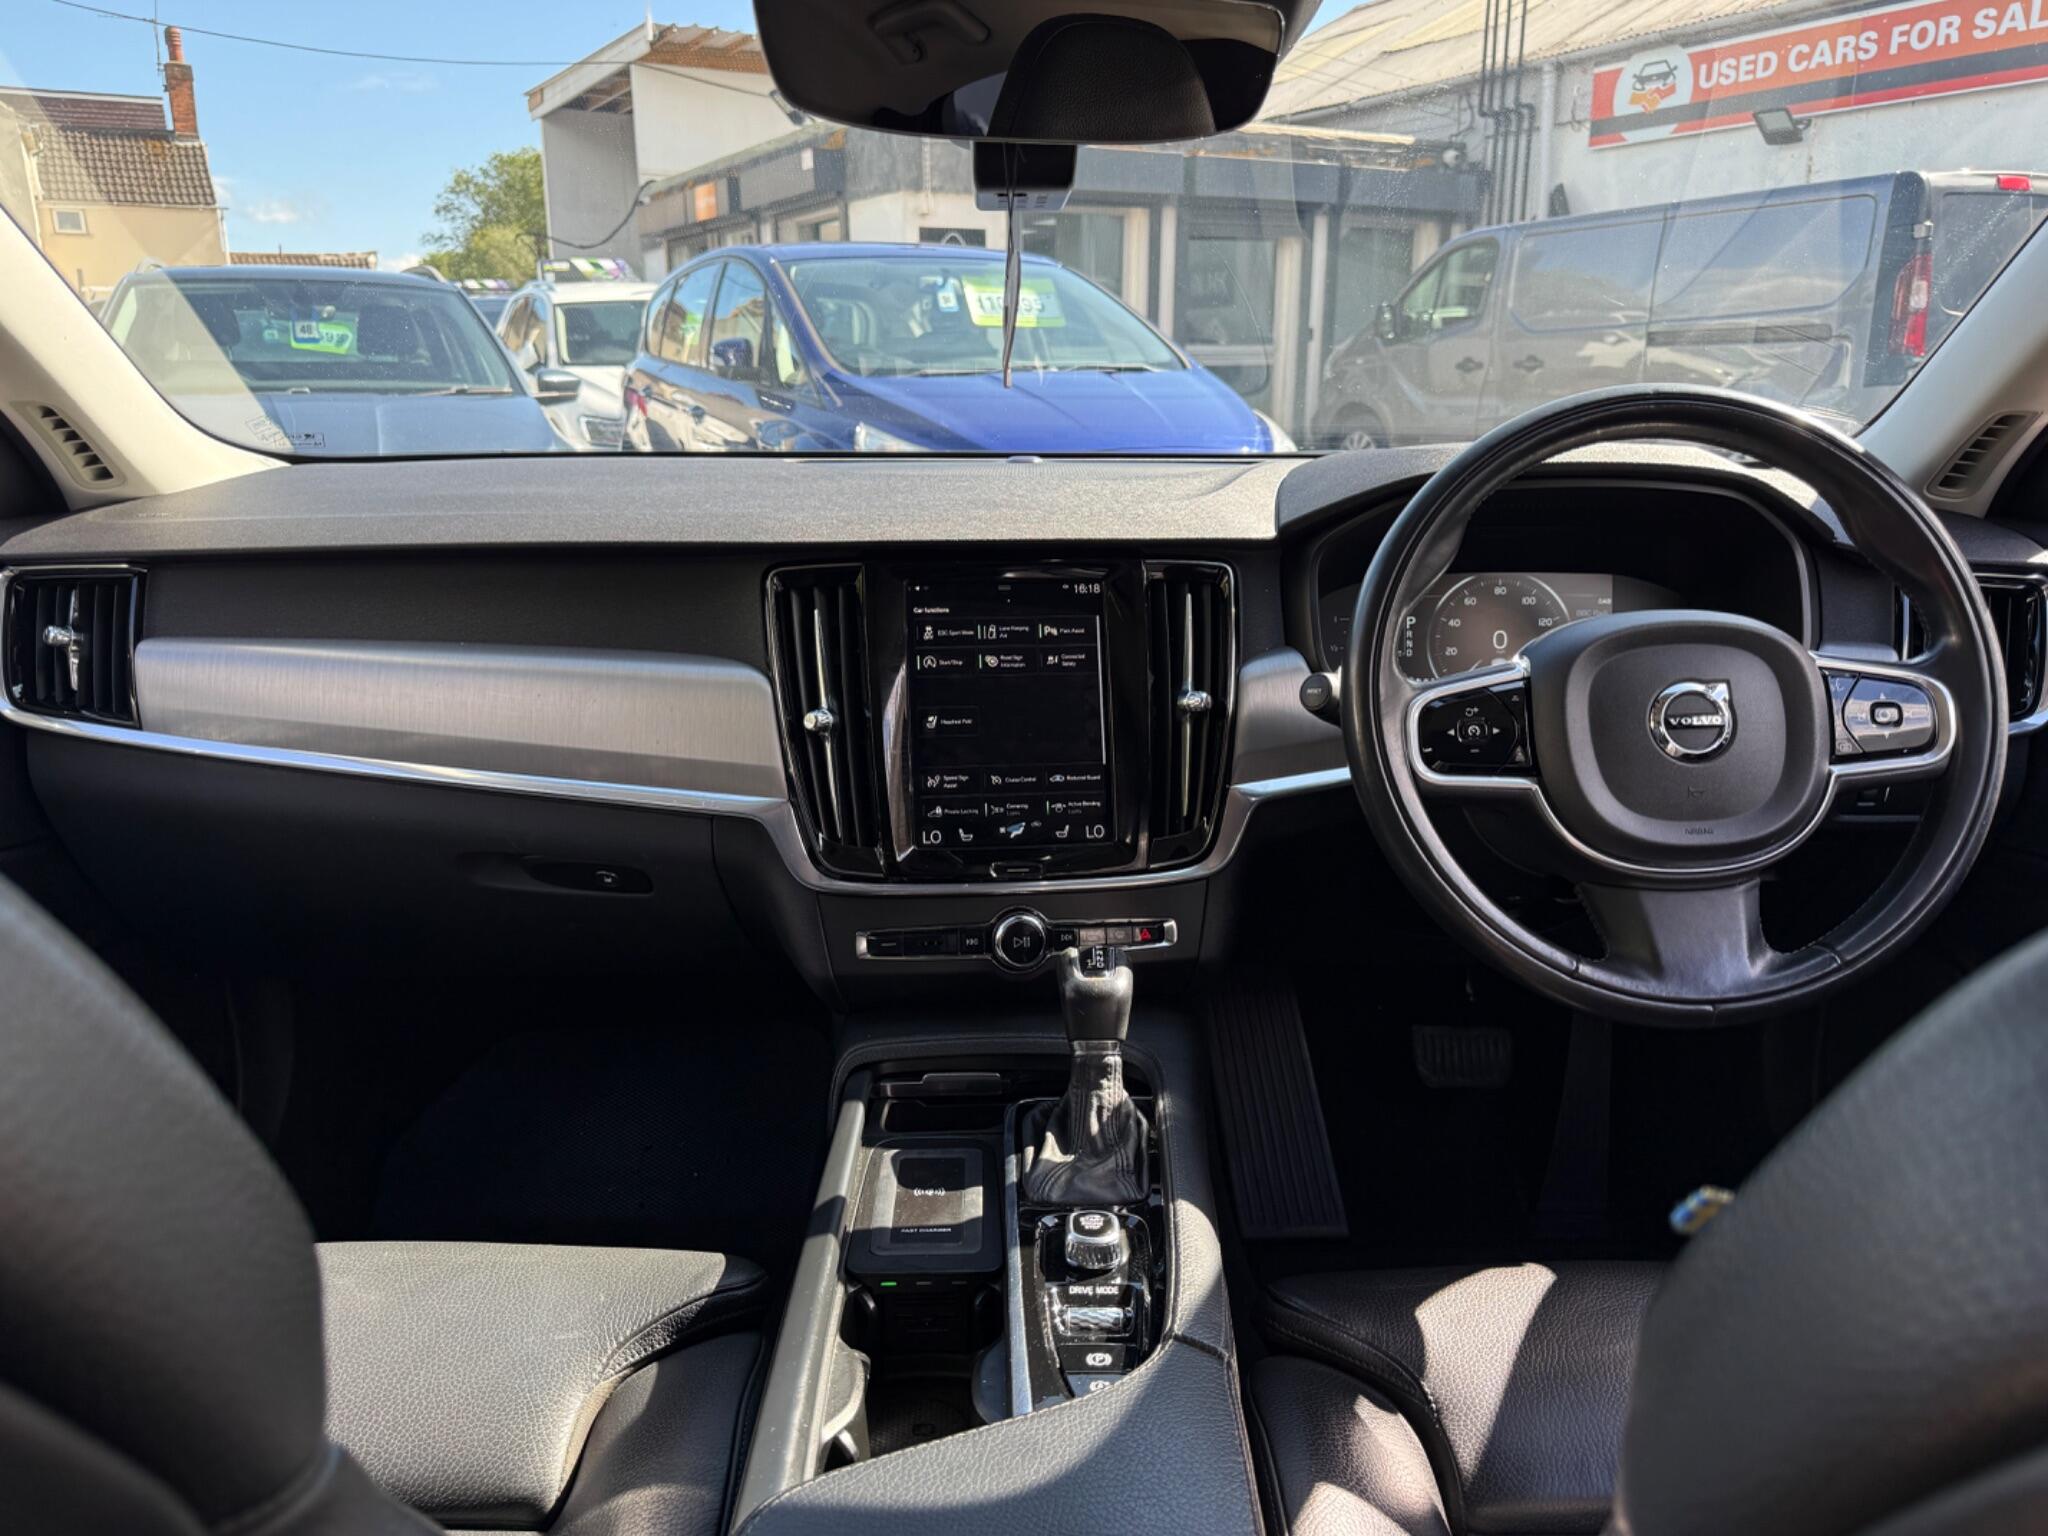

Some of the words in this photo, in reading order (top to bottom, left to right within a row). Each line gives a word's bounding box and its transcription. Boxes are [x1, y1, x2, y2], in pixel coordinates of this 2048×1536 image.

[1699, 51, 1778, 89] USED
[1788, 31, 1878, 72] CARS
[1889, 15, 1961, 55] FOR
[1074, 583, 1101, 595] 16:18
[1494, 586, 1507, 596] 80
[1464, 596, 1477, 606] 60
[1521, 596, 1537, 606] 100
[1406, 616, 1416, 629] P
[1447, 618, 1461, 628] 40
[1538, 617, 1553, 627] 120
[1492, 630, 1508, 650] 0
[1445, 646, 1458, 656] 20
[1669, 714, 1722, 726] VOLVO
[922, 829, 942, 844] LO
[1085, 824, 1105, 839] LO
[1069, 1285, 1094, 1295] DRIVE
[1095, 1285, 1120, 1294] MODE
